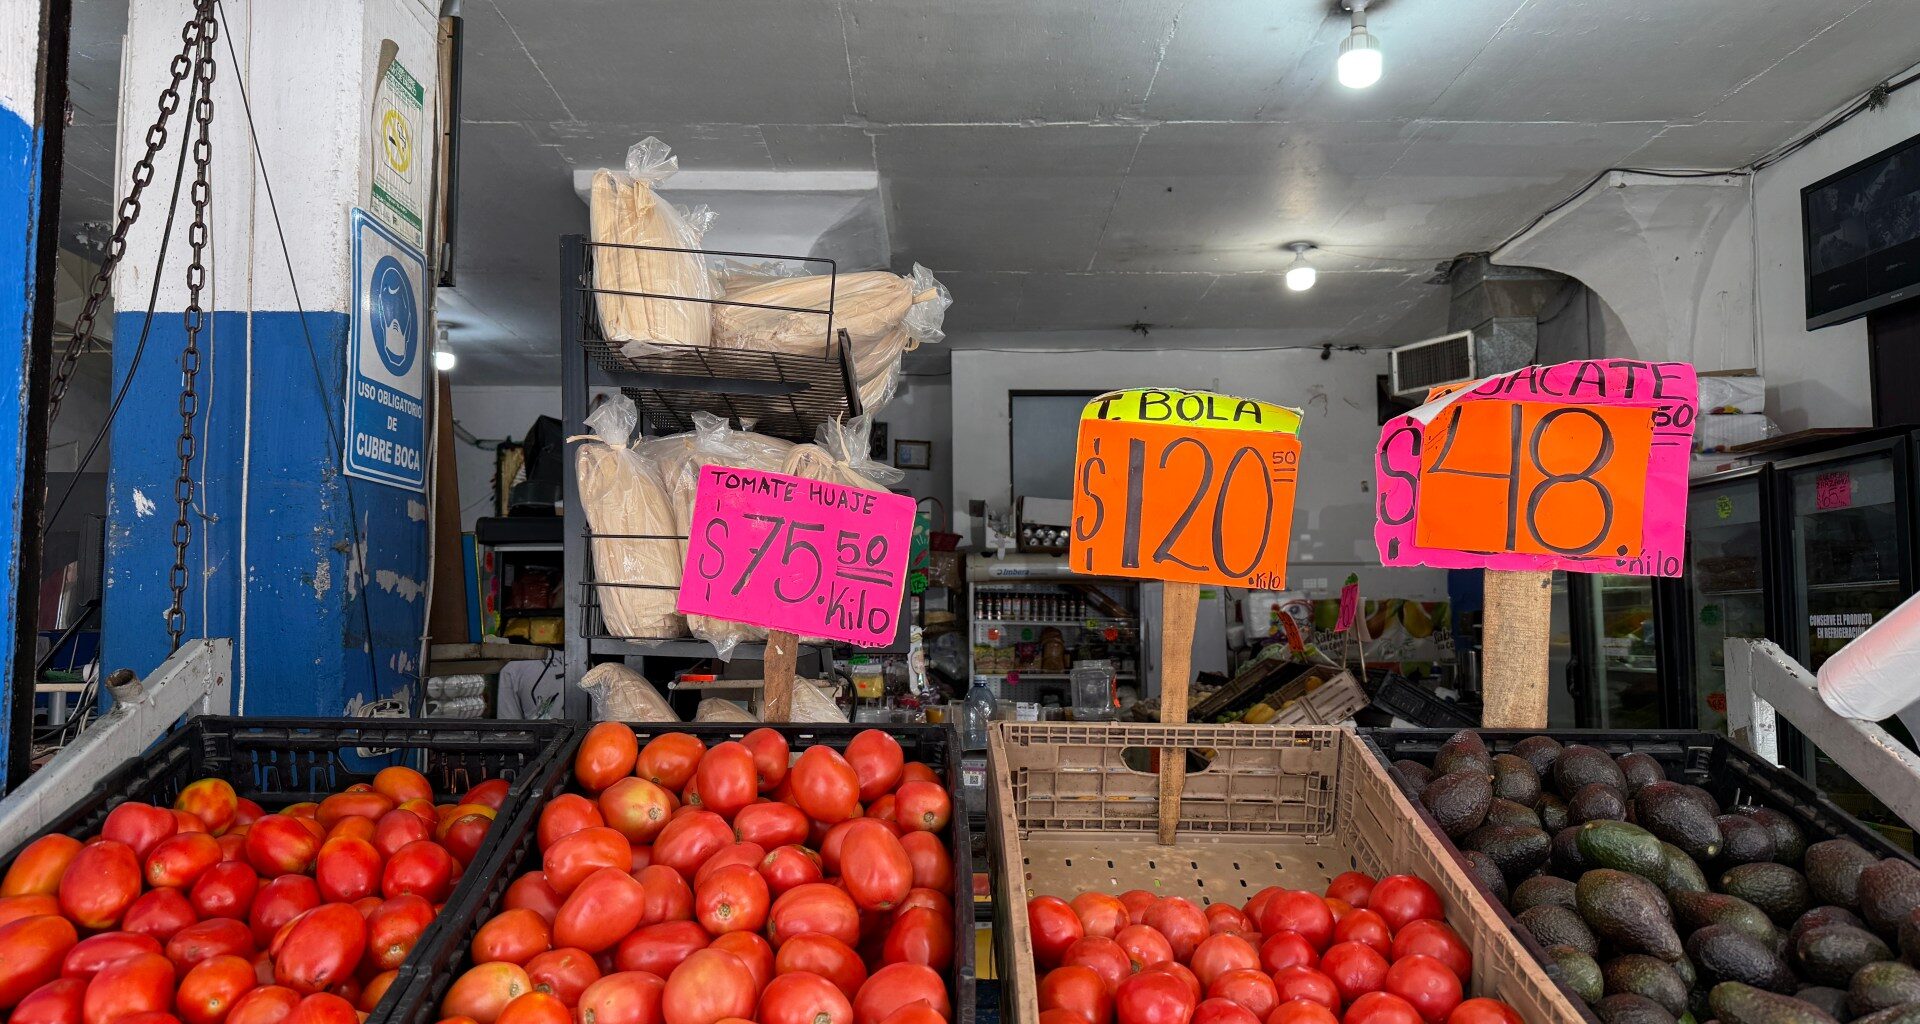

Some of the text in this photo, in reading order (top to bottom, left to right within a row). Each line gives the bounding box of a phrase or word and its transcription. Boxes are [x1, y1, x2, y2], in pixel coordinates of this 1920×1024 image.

[358, 381, 422, 419] USO OBLIGATORIO
[1138, 391, 1262, 423] BOLA
[387, 416, 398, 431] DE
[356, 432, 420, 471] CUBRE BOCA
[711, 471, 877, 515] TOMATE HUAJE
[1809, 613, 1873, 626] CONSERVE EL PRODUCTO
[1817, 627, 1824, 639] EN
